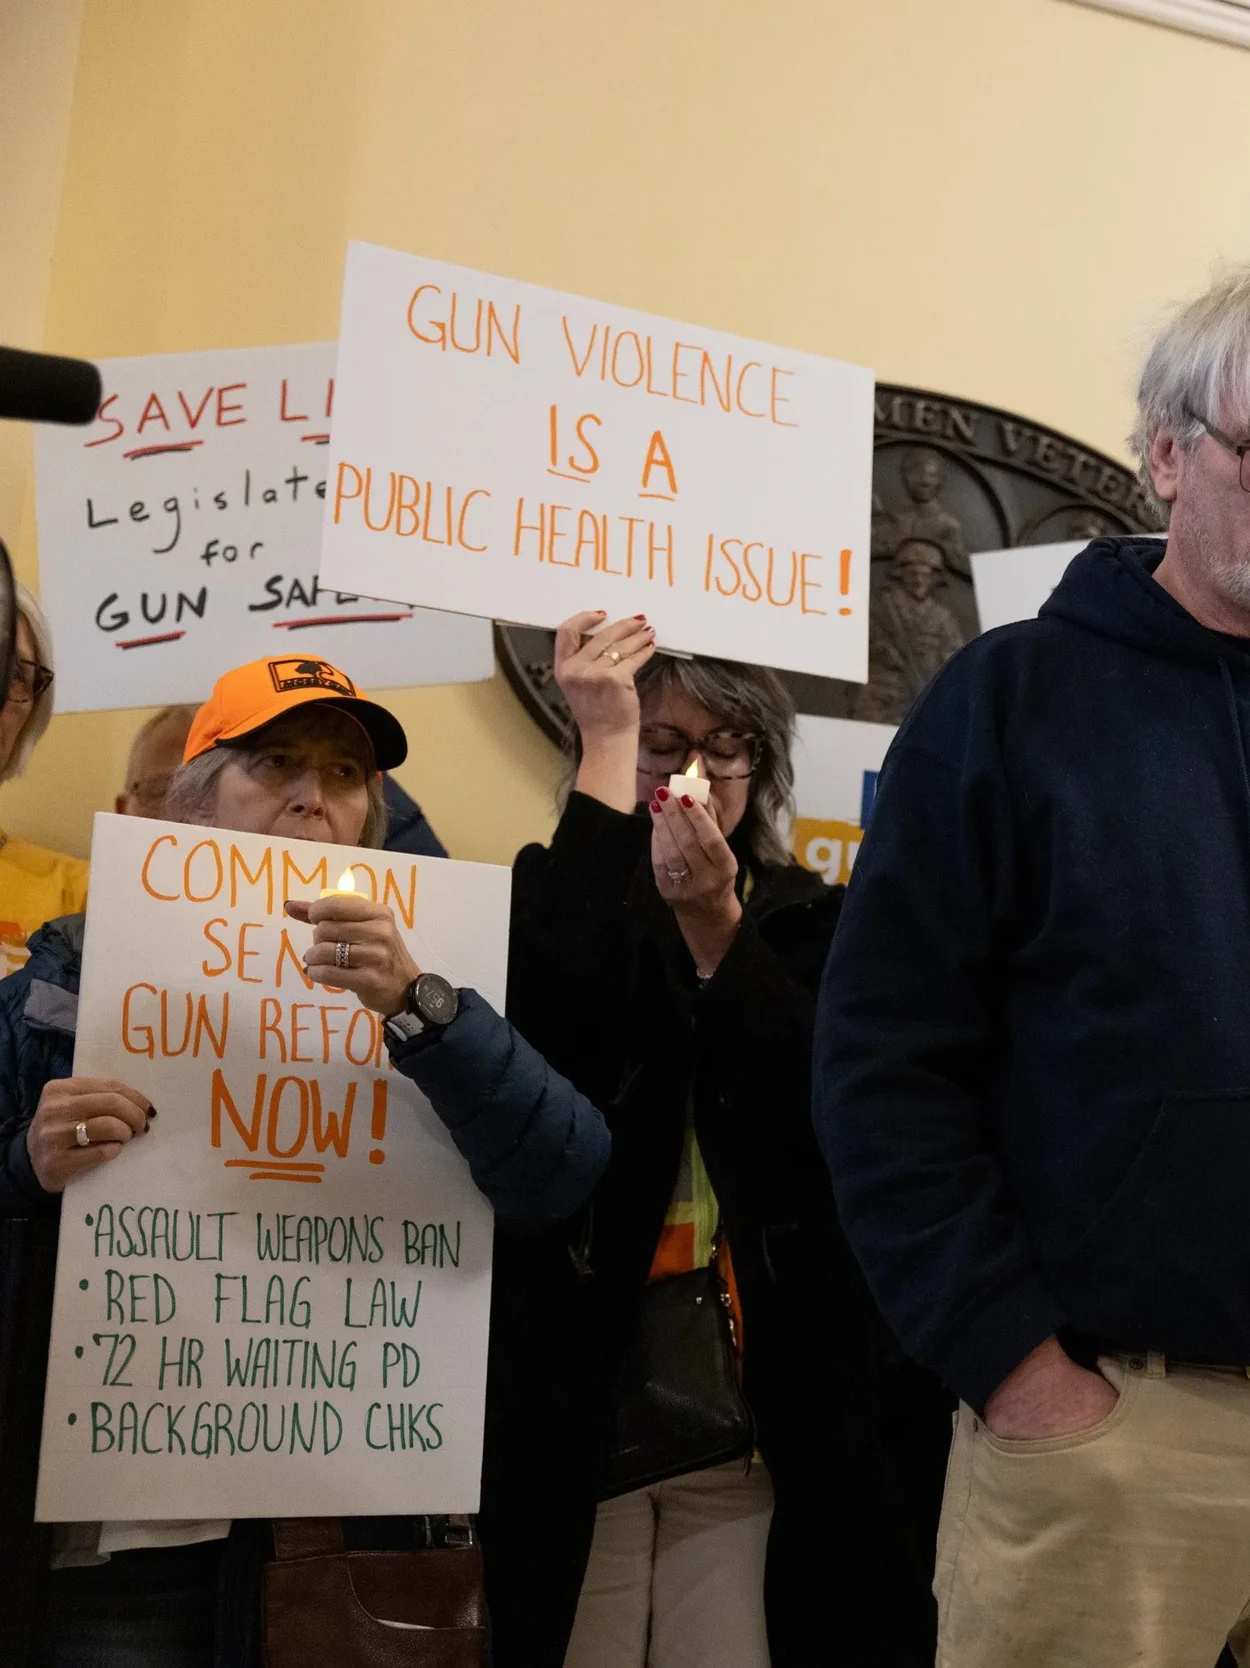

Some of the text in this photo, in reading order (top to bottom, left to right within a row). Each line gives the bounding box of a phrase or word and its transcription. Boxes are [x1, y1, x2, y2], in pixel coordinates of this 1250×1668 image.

[407, 285, 799, 428] GUN VIOLENCE
[84, 383, 247, 447] SAVE
[550, 404, 678, 494] IS A
[201, 539, 263, 566] for
[334, 462, 853, 615] PUBLIC HEALTH ISSUE!
[96, 586, 207, 632] GUN
[121, 982, 229, 1060] GUN
[211, 1068, 388, 1164] NOW!
[94, 1204, 461, 1268] ASSAULT WEAPONS BAN
[105, 1269, 422, 1328] RED FLAG LAW
[93, 1333, 420, 1391] 72 HR WAITING PD
[91, 1400, 444, 1460] BACKGROUND CHKS
